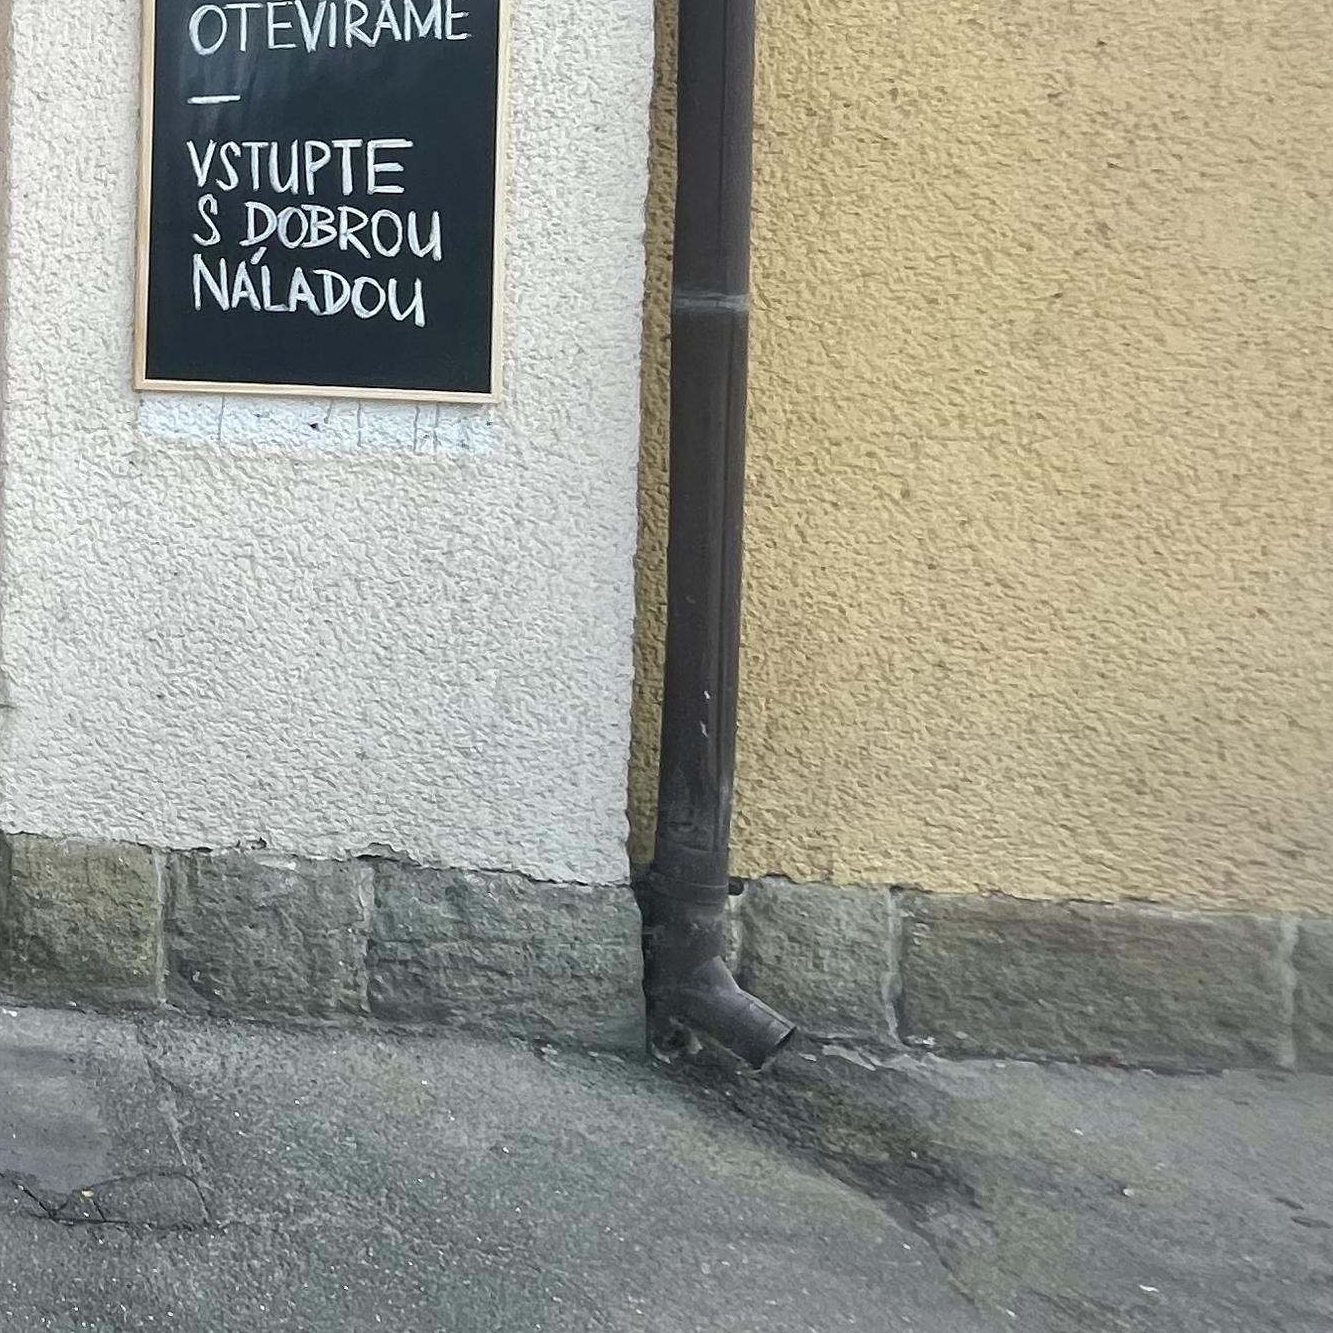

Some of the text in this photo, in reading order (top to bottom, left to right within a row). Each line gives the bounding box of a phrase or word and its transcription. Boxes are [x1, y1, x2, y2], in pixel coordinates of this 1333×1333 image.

[186, 137, 415, 197] VSTUPTE
[193, 193, 443, 262] S DOBROU
[192, 246, 427, 328] NÁLADOU
